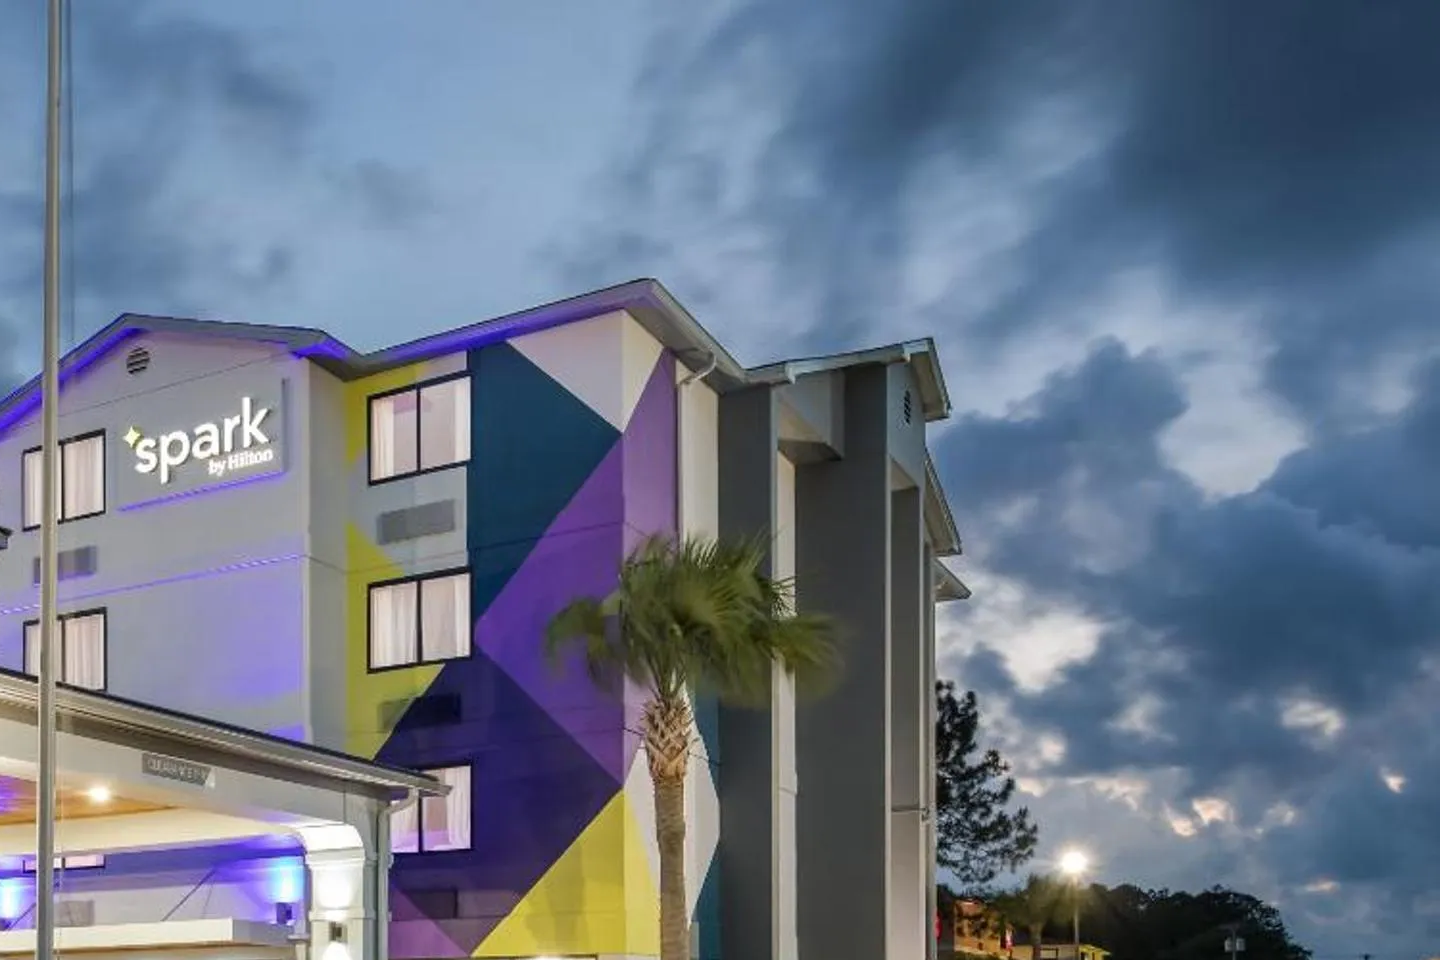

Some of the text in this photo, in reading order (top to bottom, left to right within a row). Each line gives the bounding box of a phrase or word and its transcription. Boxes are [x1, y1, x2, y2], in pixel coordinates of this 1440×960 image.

[134, 397, 270, 484] spark
[208, 449, 273, 476] by Hilton
